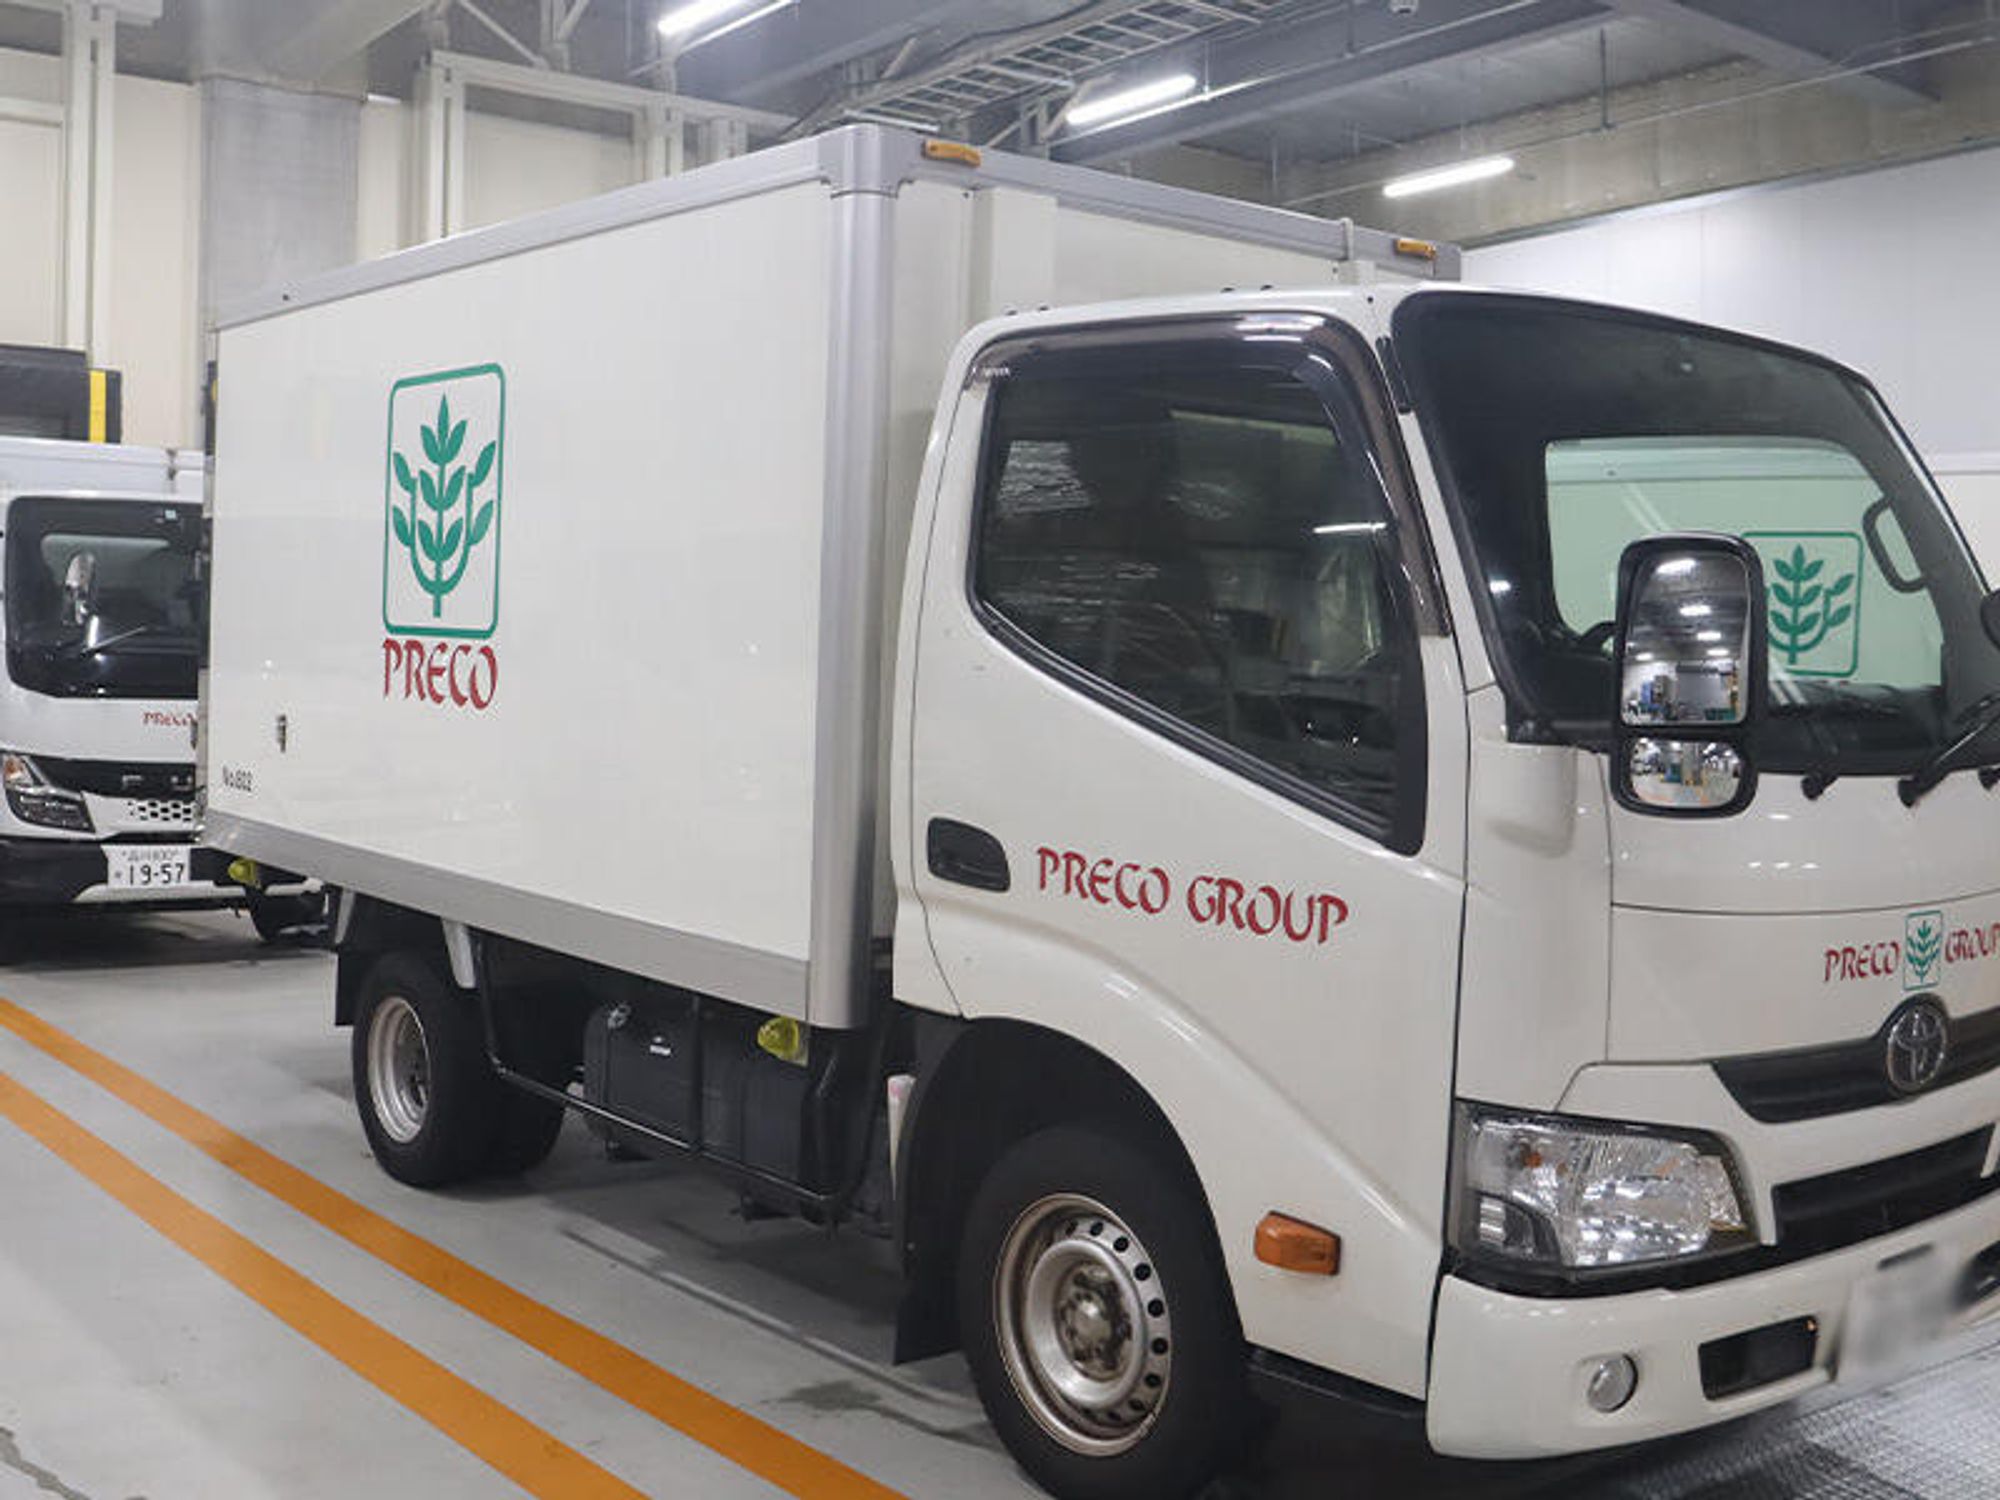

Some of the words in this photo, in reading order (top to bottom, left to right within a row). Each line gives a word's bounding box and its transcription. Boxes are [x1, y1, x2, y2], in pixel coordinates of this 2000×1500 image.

[383, 638, 498, 710] PRECO
[129, 862, 184, 886] 19-57
[1037, 846, 1170, 914] PRECO
[1187, 875, 1349, 943] GROUP
[1824, 941, 1899, 981] PRECO
